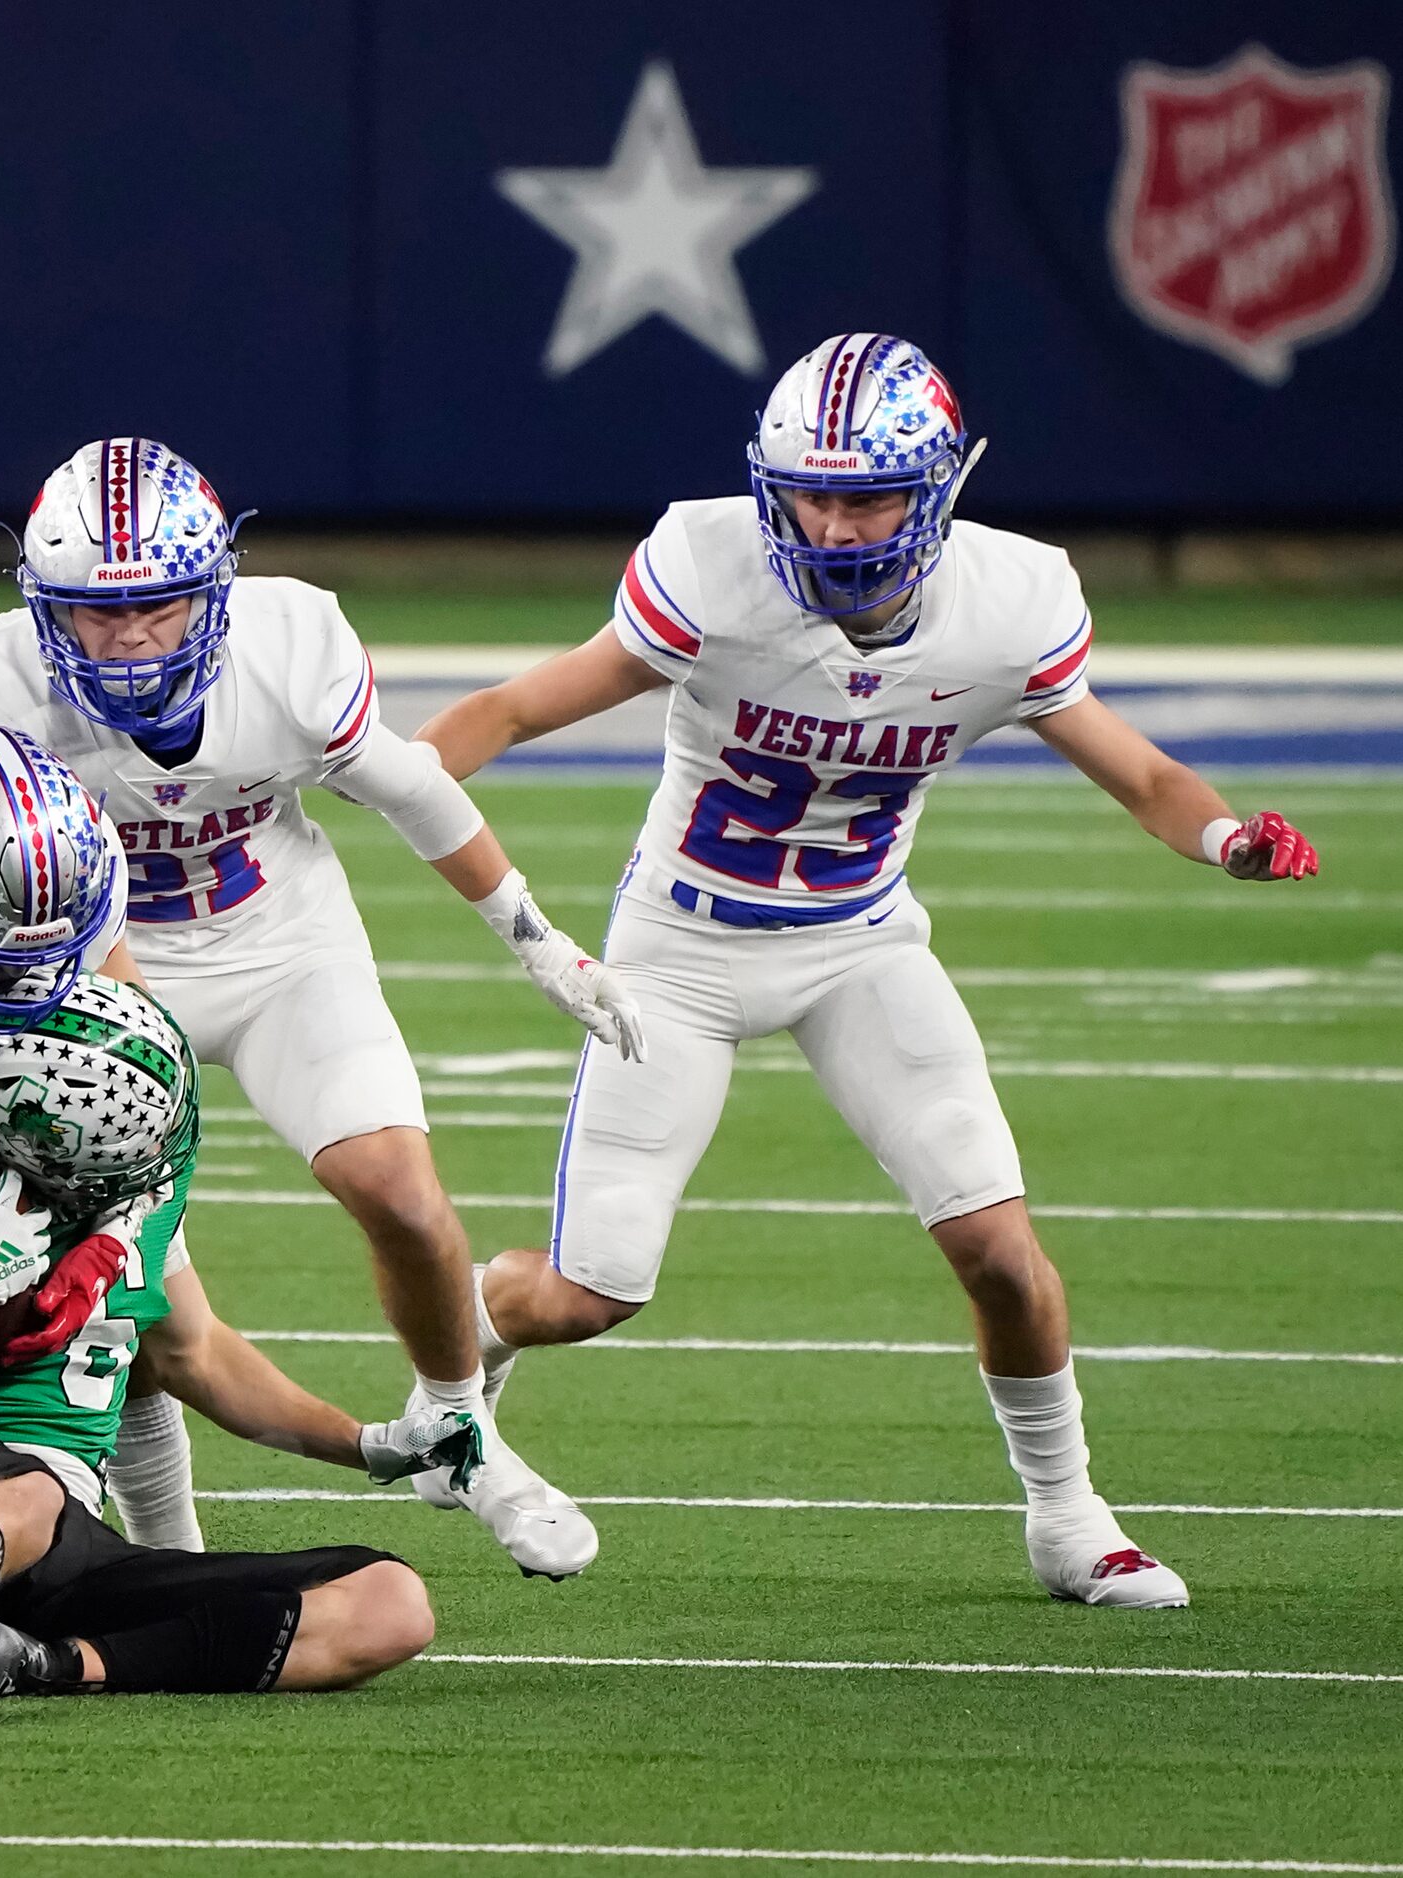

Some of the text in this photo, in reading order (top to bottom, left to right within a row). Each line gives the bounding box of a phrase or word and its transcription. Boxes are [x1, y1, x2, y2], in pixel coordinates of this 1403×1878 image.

[804, 455, 857, 469] Riddell
[97, 566, 152, 581] Riddell
[734, 699, 959, 768] WESTLAKE
[115, 794, 275, 850] STLAKE
[678, 746, 930, 892] 23
[127, 832, 267, 924] 21
[15, 927, 67, 943] Riddell
